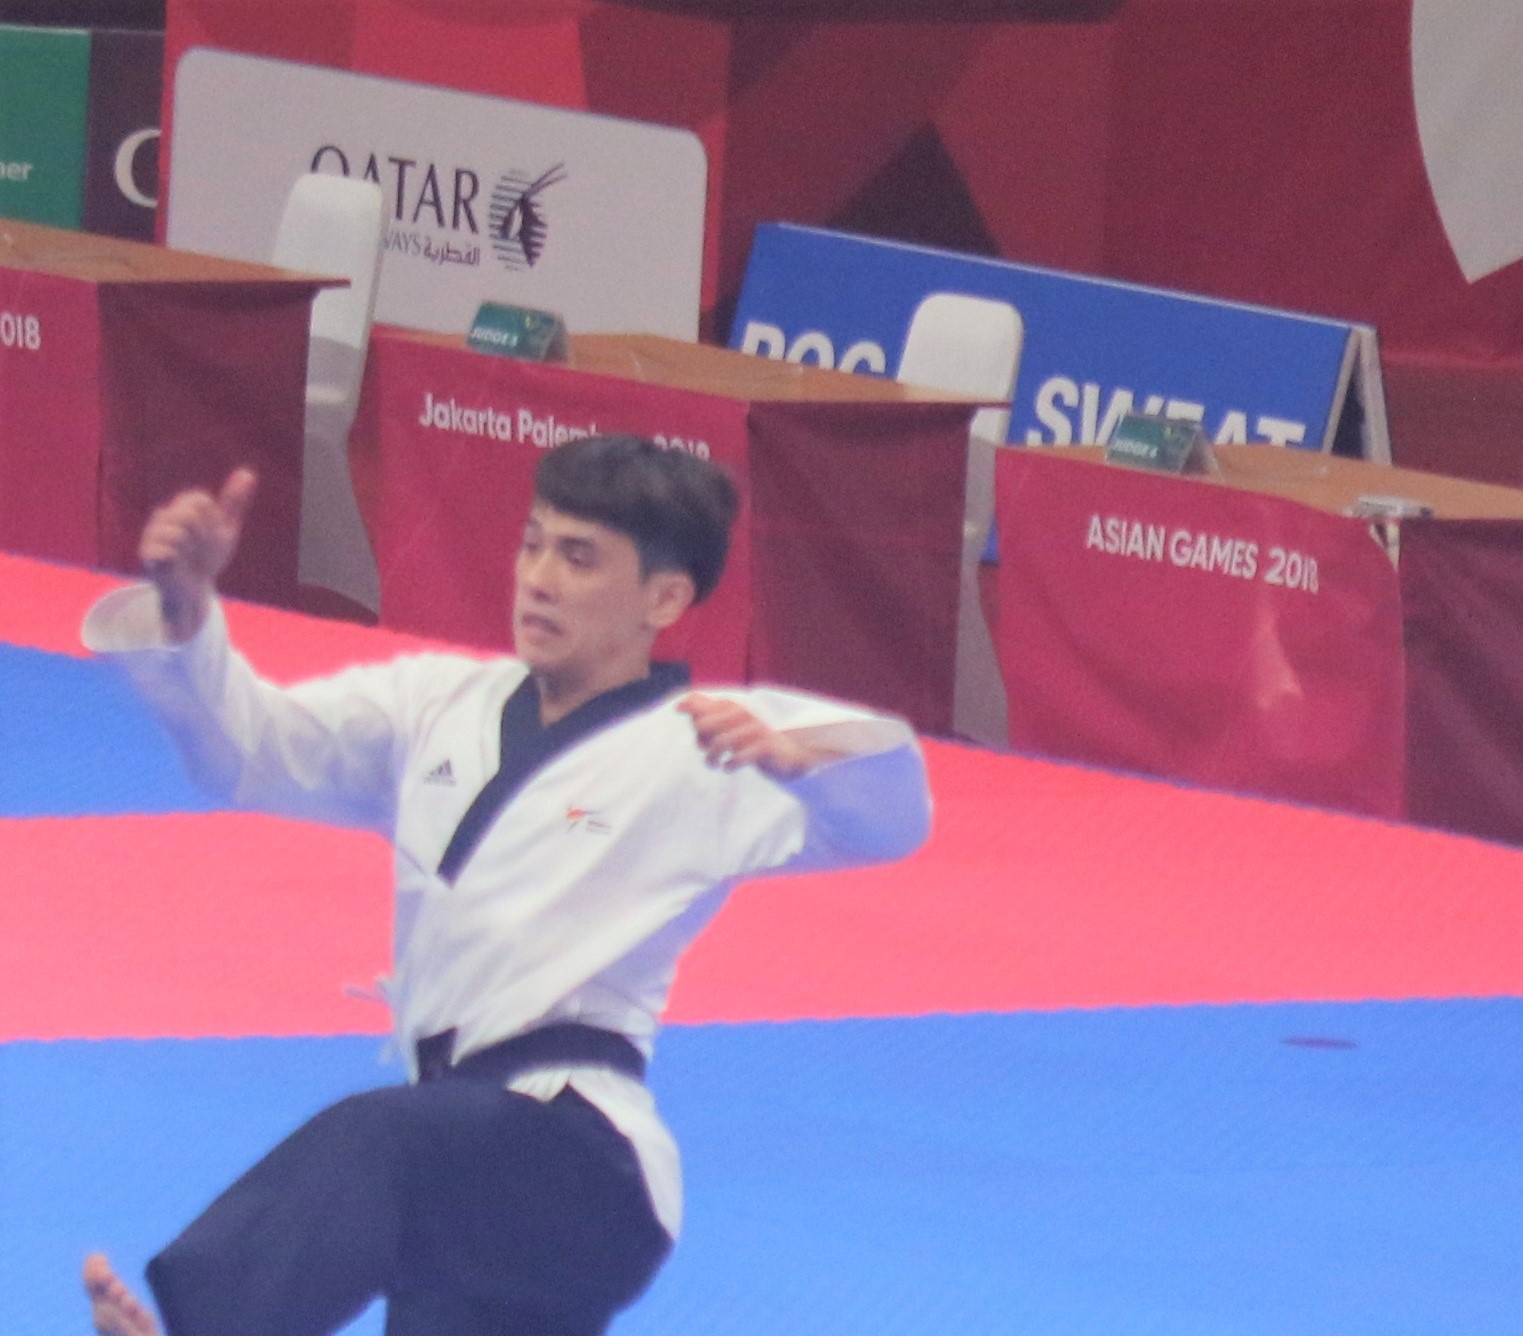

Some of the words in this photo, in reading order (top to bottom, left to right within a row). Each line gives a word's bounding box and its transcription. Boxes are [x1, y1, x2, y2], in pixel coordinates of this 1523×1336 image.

[419, 391, 512, 442] Jakarta
[1025, 375, 1306, 447] SWT
[1087, 514, 1165, 563] ASIAN
[1170, 529, 1259, 580] GAMES
